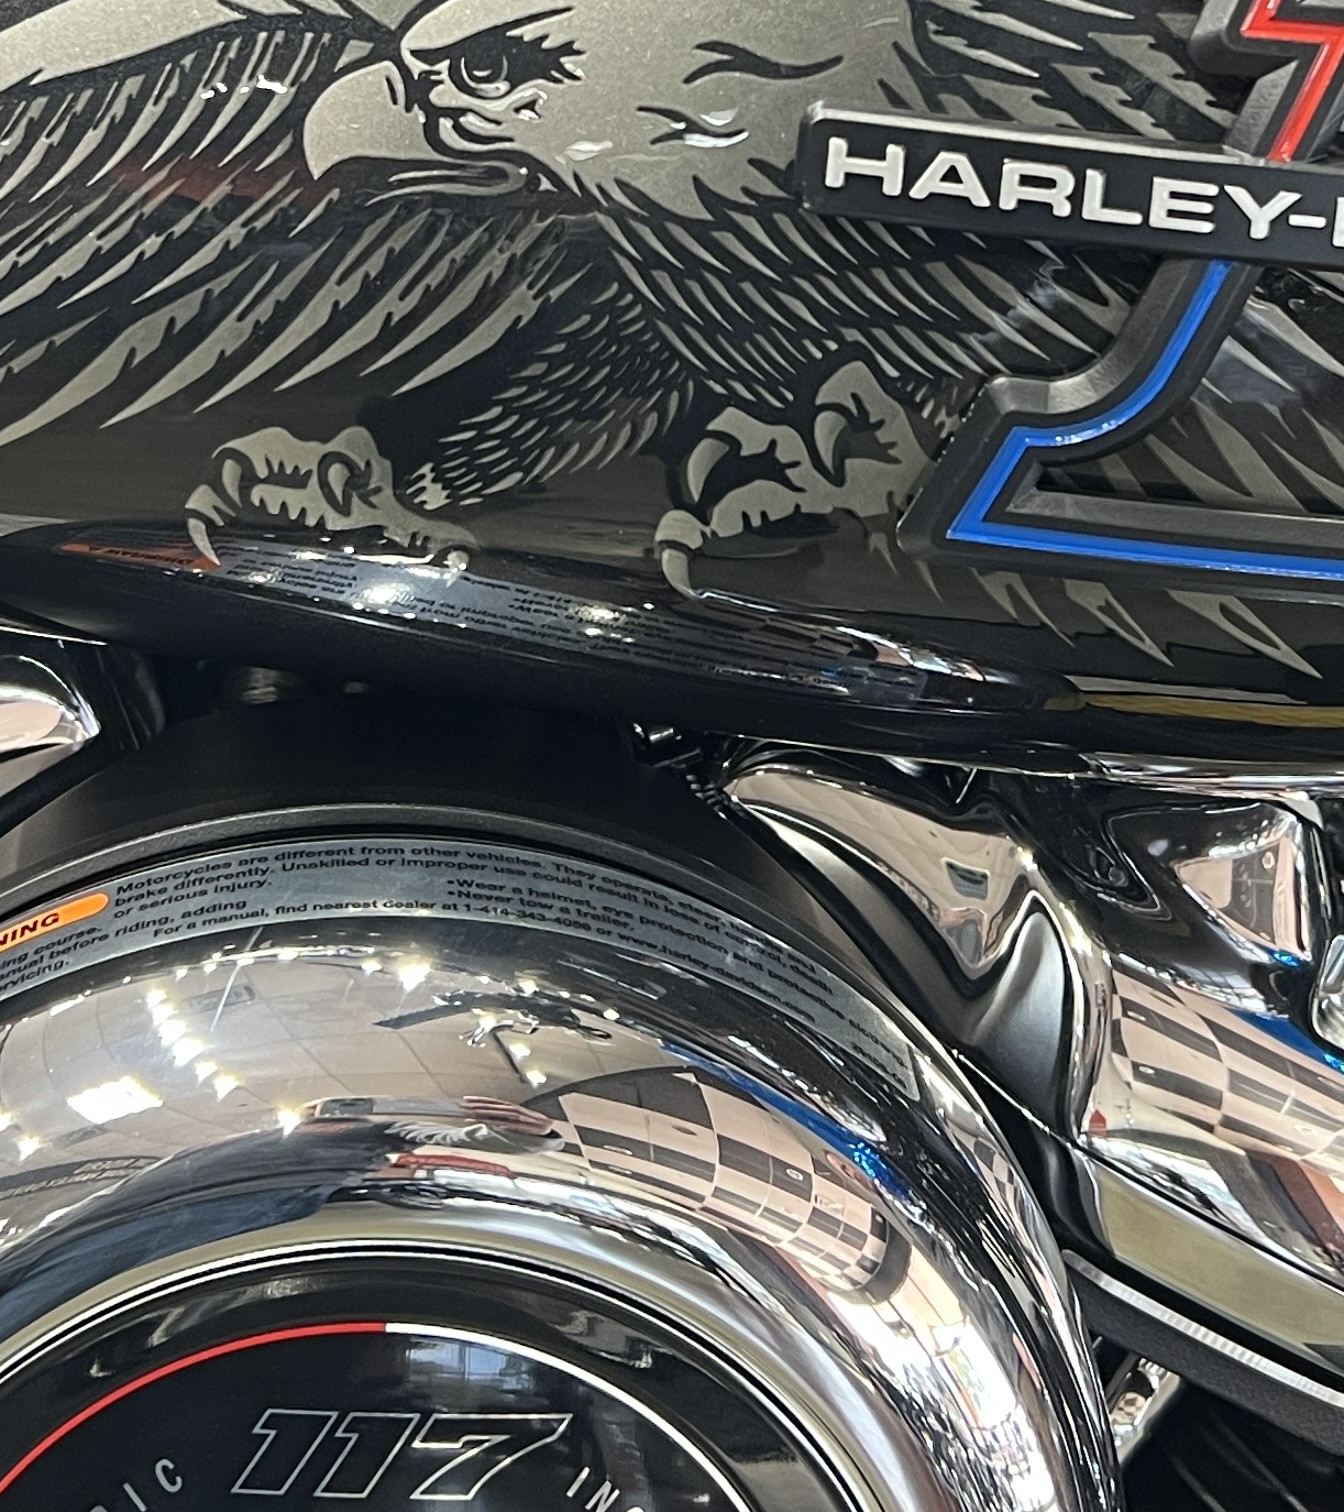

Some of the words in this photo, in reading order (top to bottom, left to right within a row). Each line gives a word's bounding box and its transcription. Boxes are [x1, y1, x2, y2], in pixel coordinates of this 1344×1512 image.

[114, 886, 169, 908] brake
[173, 866, 276, 891] differently.
[281, 857, 370, 873] Unskilled
[374, 858, 396, 867] or
[400, 856, 489, 872] improper
[493, 865, 528, 877] use
[531, 871, 584, 889] could
[587, 883, 640, 904] result
[116, 861, 233, 896] Motorcycles
[237, 855, 270, 867] are
[273, 846, 355, 862] different
[360, 845, 406, 856] from
[410, 846, 462, 858] other
[553, 862, 597, 881] They
[113, 906, 134, 919] or
[138, 888, 209, 912] serious
[213, 878, 272, 894] injury.
[152, 924, 183, 938] For
[184, 919, 197, 931] a
[201, 907, 270, 927] manual,
[274, 903, 308, 915] find
[310, 898, 378, 911] nearest
[441, 902, 459, 912] at
[509, 885, 523, 894] a
[527, 887, 598, 912] helmet,
[518, 896, 555, 911] tow
[557, 903, 572, 915] a
[33, 926, 103, 956] course.
[48, 933, 110, 960] before
[114, 915, 175, 938] riding,
[180, 900, 248, 920] adding
[231, 1408, 572, 1501] 117
[566, 1466, 645, 1512] IN
